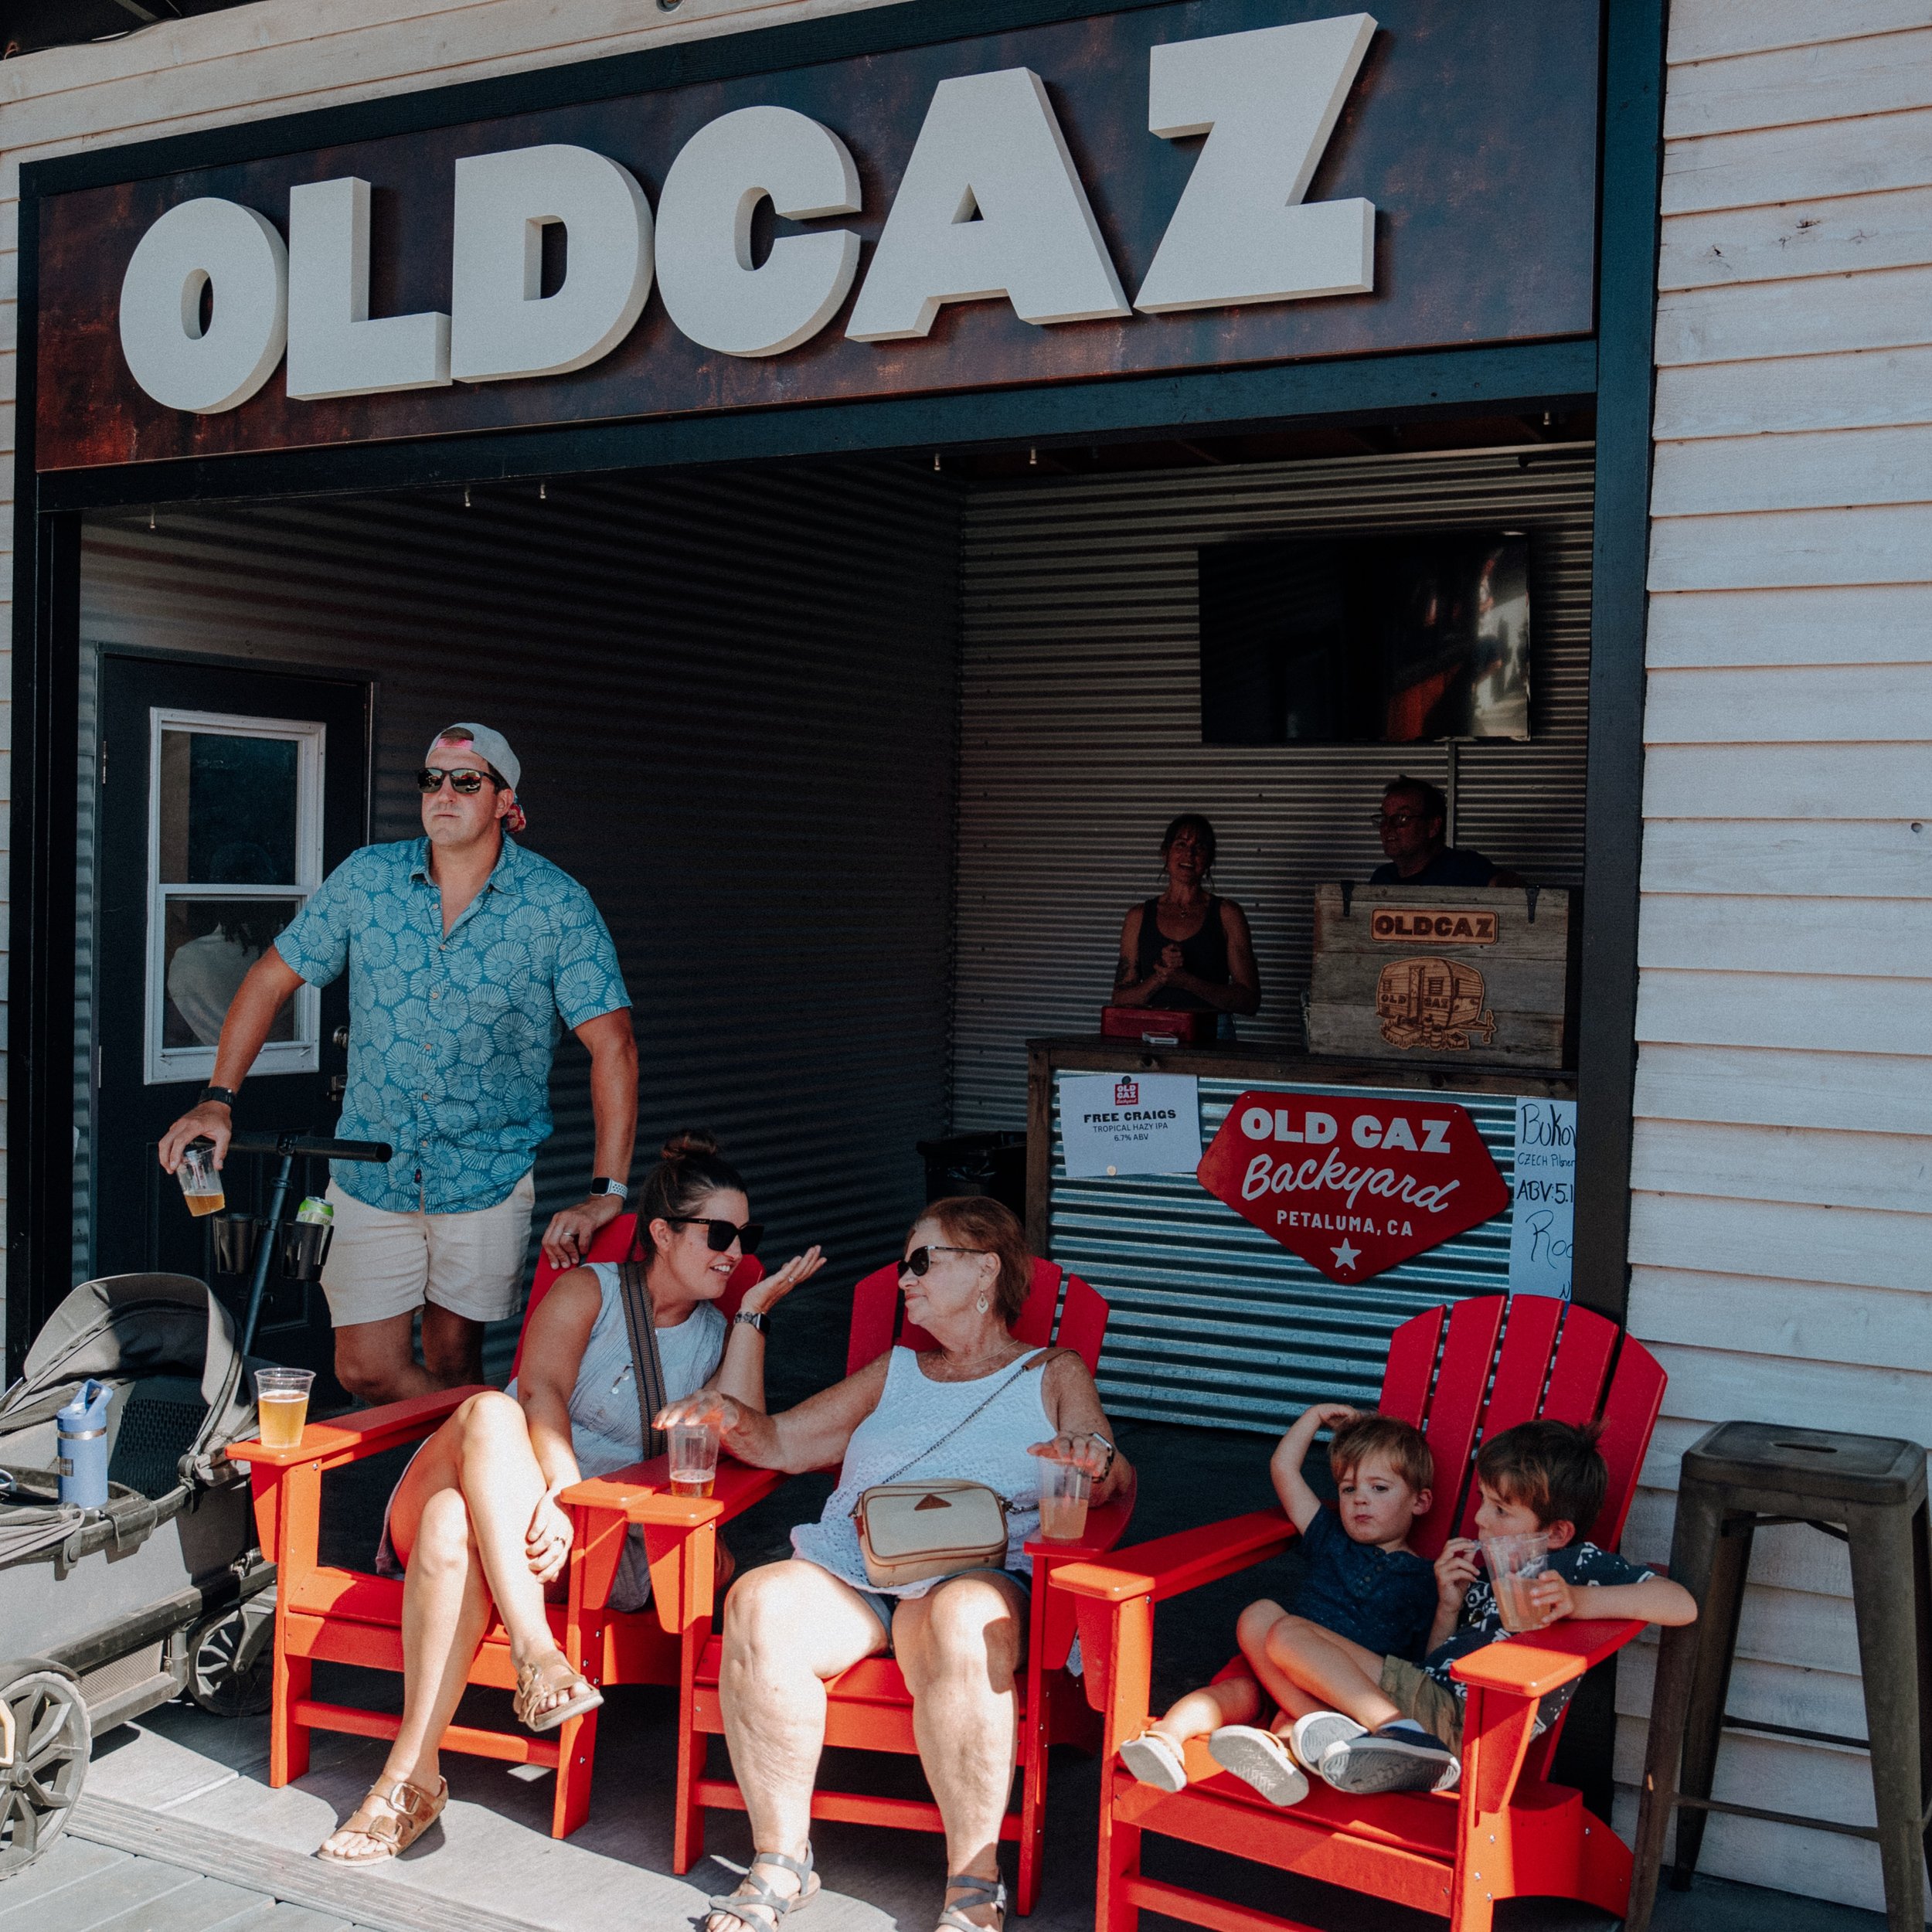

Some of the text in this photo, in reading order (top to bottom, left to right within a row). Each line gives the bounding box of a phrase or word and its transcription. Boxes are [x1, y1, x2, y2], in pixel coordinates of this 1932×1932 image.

[118, 12, 1378, 414] OLDCAZ
[1375, 915, 1493, 937] OLDCAZ
[1381, 994, 1406, 1004] OLD
[1117, 1084, 1137, 1093] OLD
[1083, 1110, 1176, 1123] FREE CRAIGS
[1093, 1124, 1131, 1133] TROPICAL
[1240, 1107, 1451, 1154] OLD CAZ
[1518, 1152, 1548, 1166] CZECH
[1241, 1147, 1461, 1213] Backyard
[1277, 1209, 1413, 1236] PETALUMA, CA
